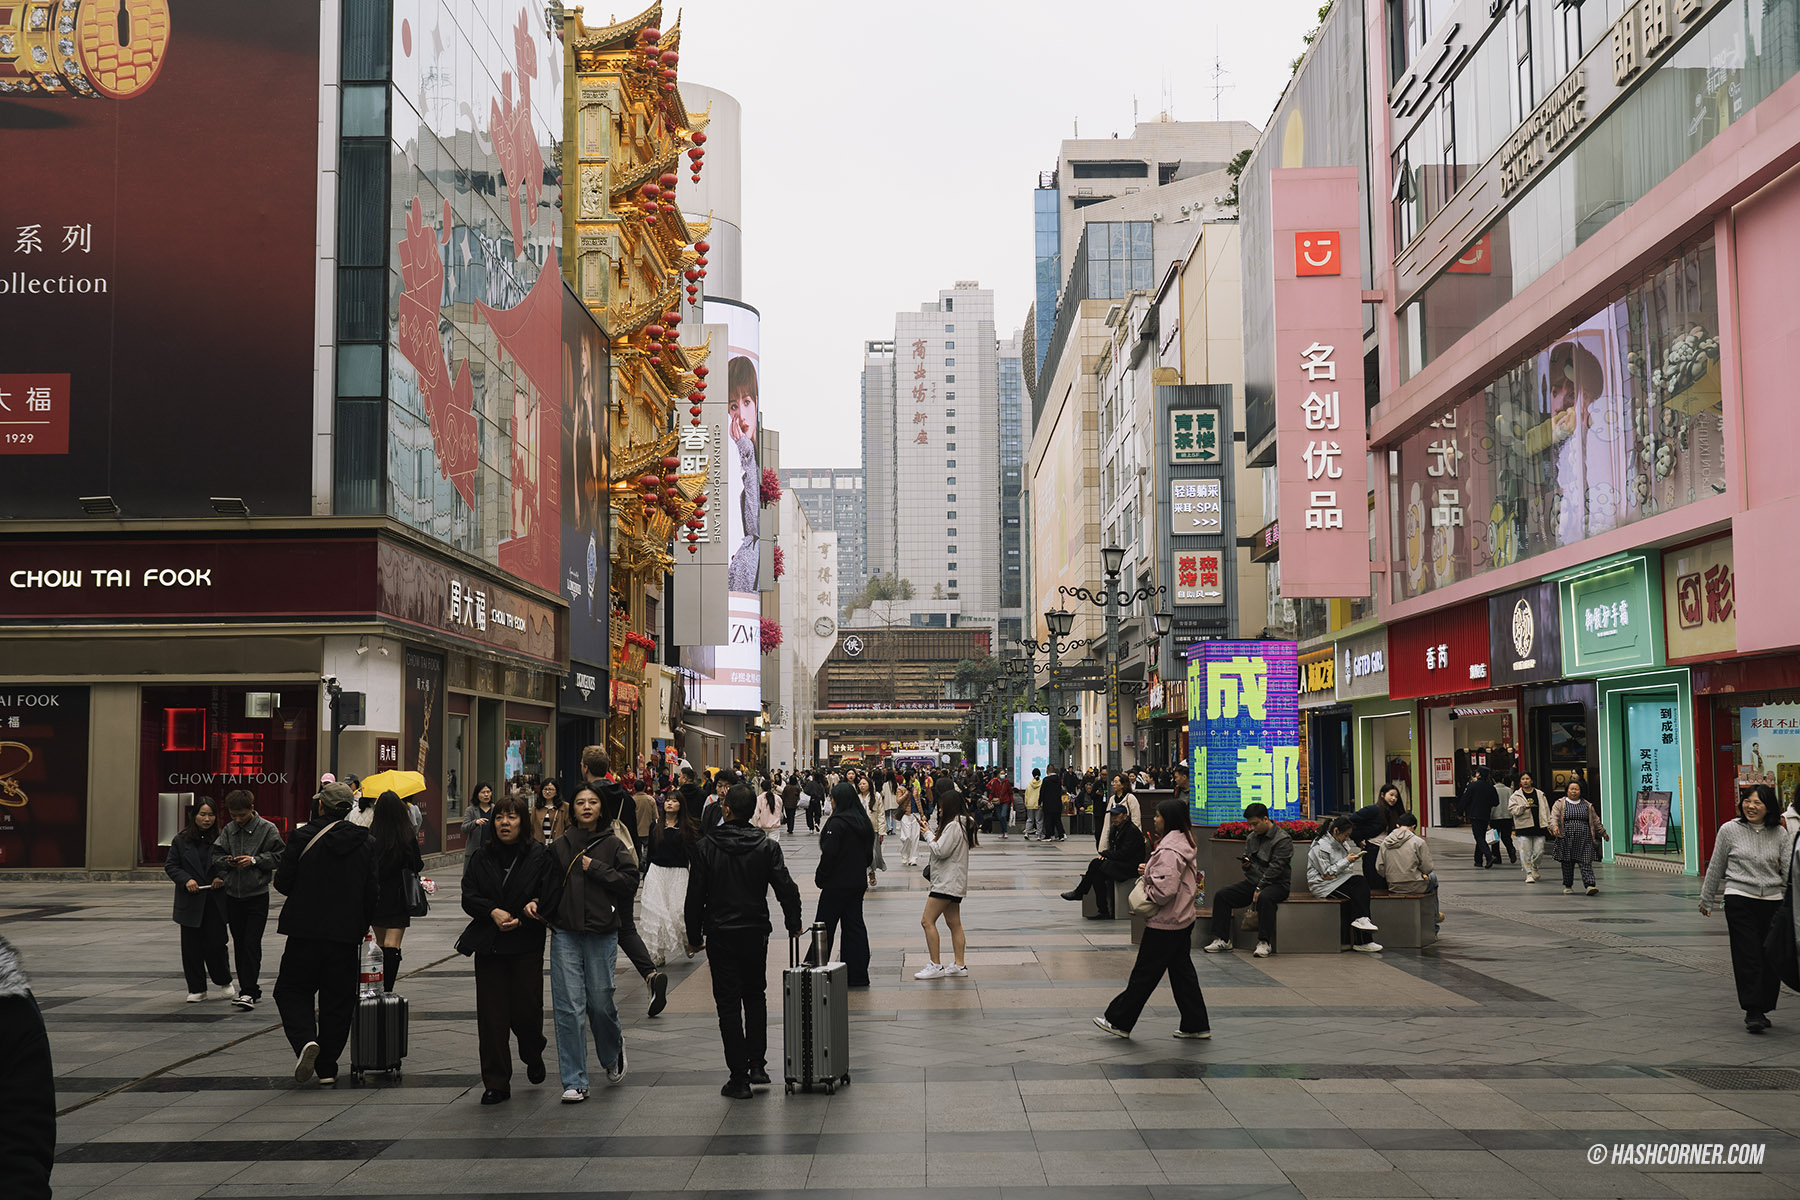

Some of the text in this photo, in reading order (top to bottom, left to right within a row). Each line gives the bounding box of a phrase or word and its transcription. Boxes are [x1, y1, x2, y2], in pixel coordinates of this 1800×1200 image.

[1500, 94, 1587, 198] DENTAL CLINIC
[14, 224, 92, 254] 系列
[5, 433, 34, 444] 1929
[1299, 342, 1344, 530] 名创优品
[713, 424, 722, 544] CHUNXI NORTH LANE
[9, 568, 212, 588] CHOW TAI FOOK
[817, 542, 832, 607] 亨得利
[450, 580, 486, 632] 周大福
[1704, 564, 1736, 623] 彩
[492, 609, 526, 633] CHOW TAI FOOK
[406, 653, 440, 671] CHOW TAI FOOK
[1353, 649, 1384, 677] GIFTED GIRL
[417, 677, 430, 692] 周大福
[1206, 656, 1268, 721] 成
[17, 695, 60, 707] FOOK
[1660, 707, 1674, 745] 到成都
[1750, 718, 1800, 729] 彩虹 不止
[380, 744, 397, 761] 周大福
[832, 743, 855, 753] 甘食记
[169, 773, 288, 785] CHOW TAI FOOK
[1236, 745, 1299, 810] 都
